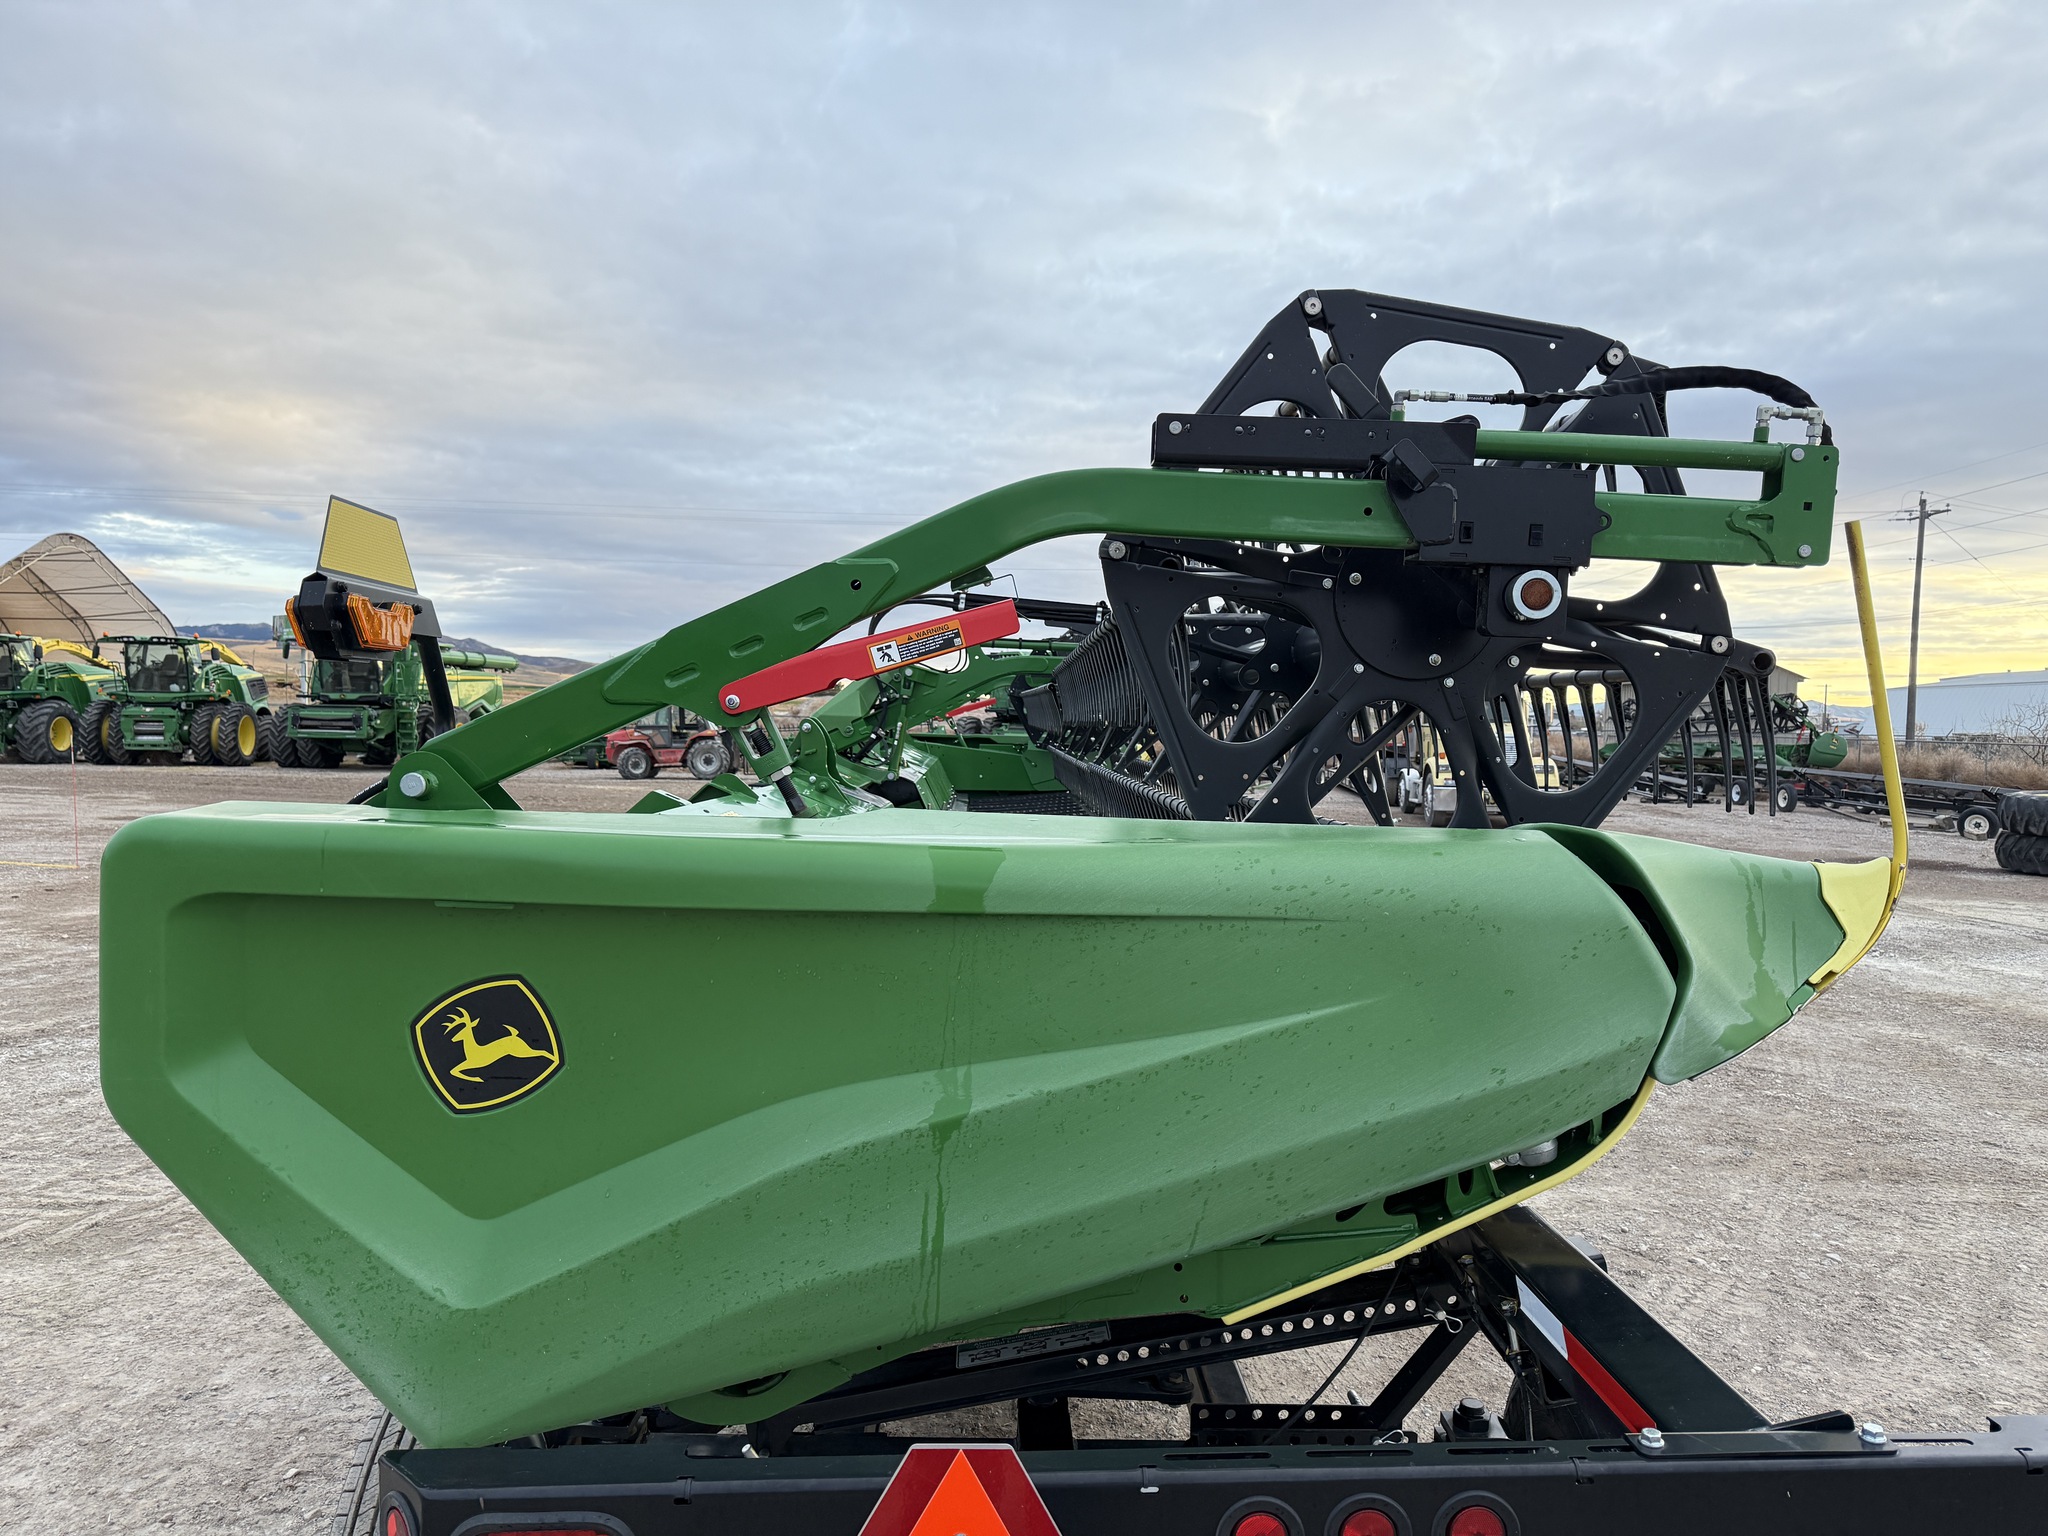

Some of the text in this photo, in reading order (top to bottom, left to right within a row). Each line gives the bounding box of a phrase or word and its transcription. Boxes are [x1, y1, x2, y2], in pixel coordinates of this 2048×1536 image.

[1183, 423, 1191, 433] 4
[1247, 425, 1256, 436] 3
[1316, 427, 1325, 441] 2
[914, 623, 950, 639] WARNING
